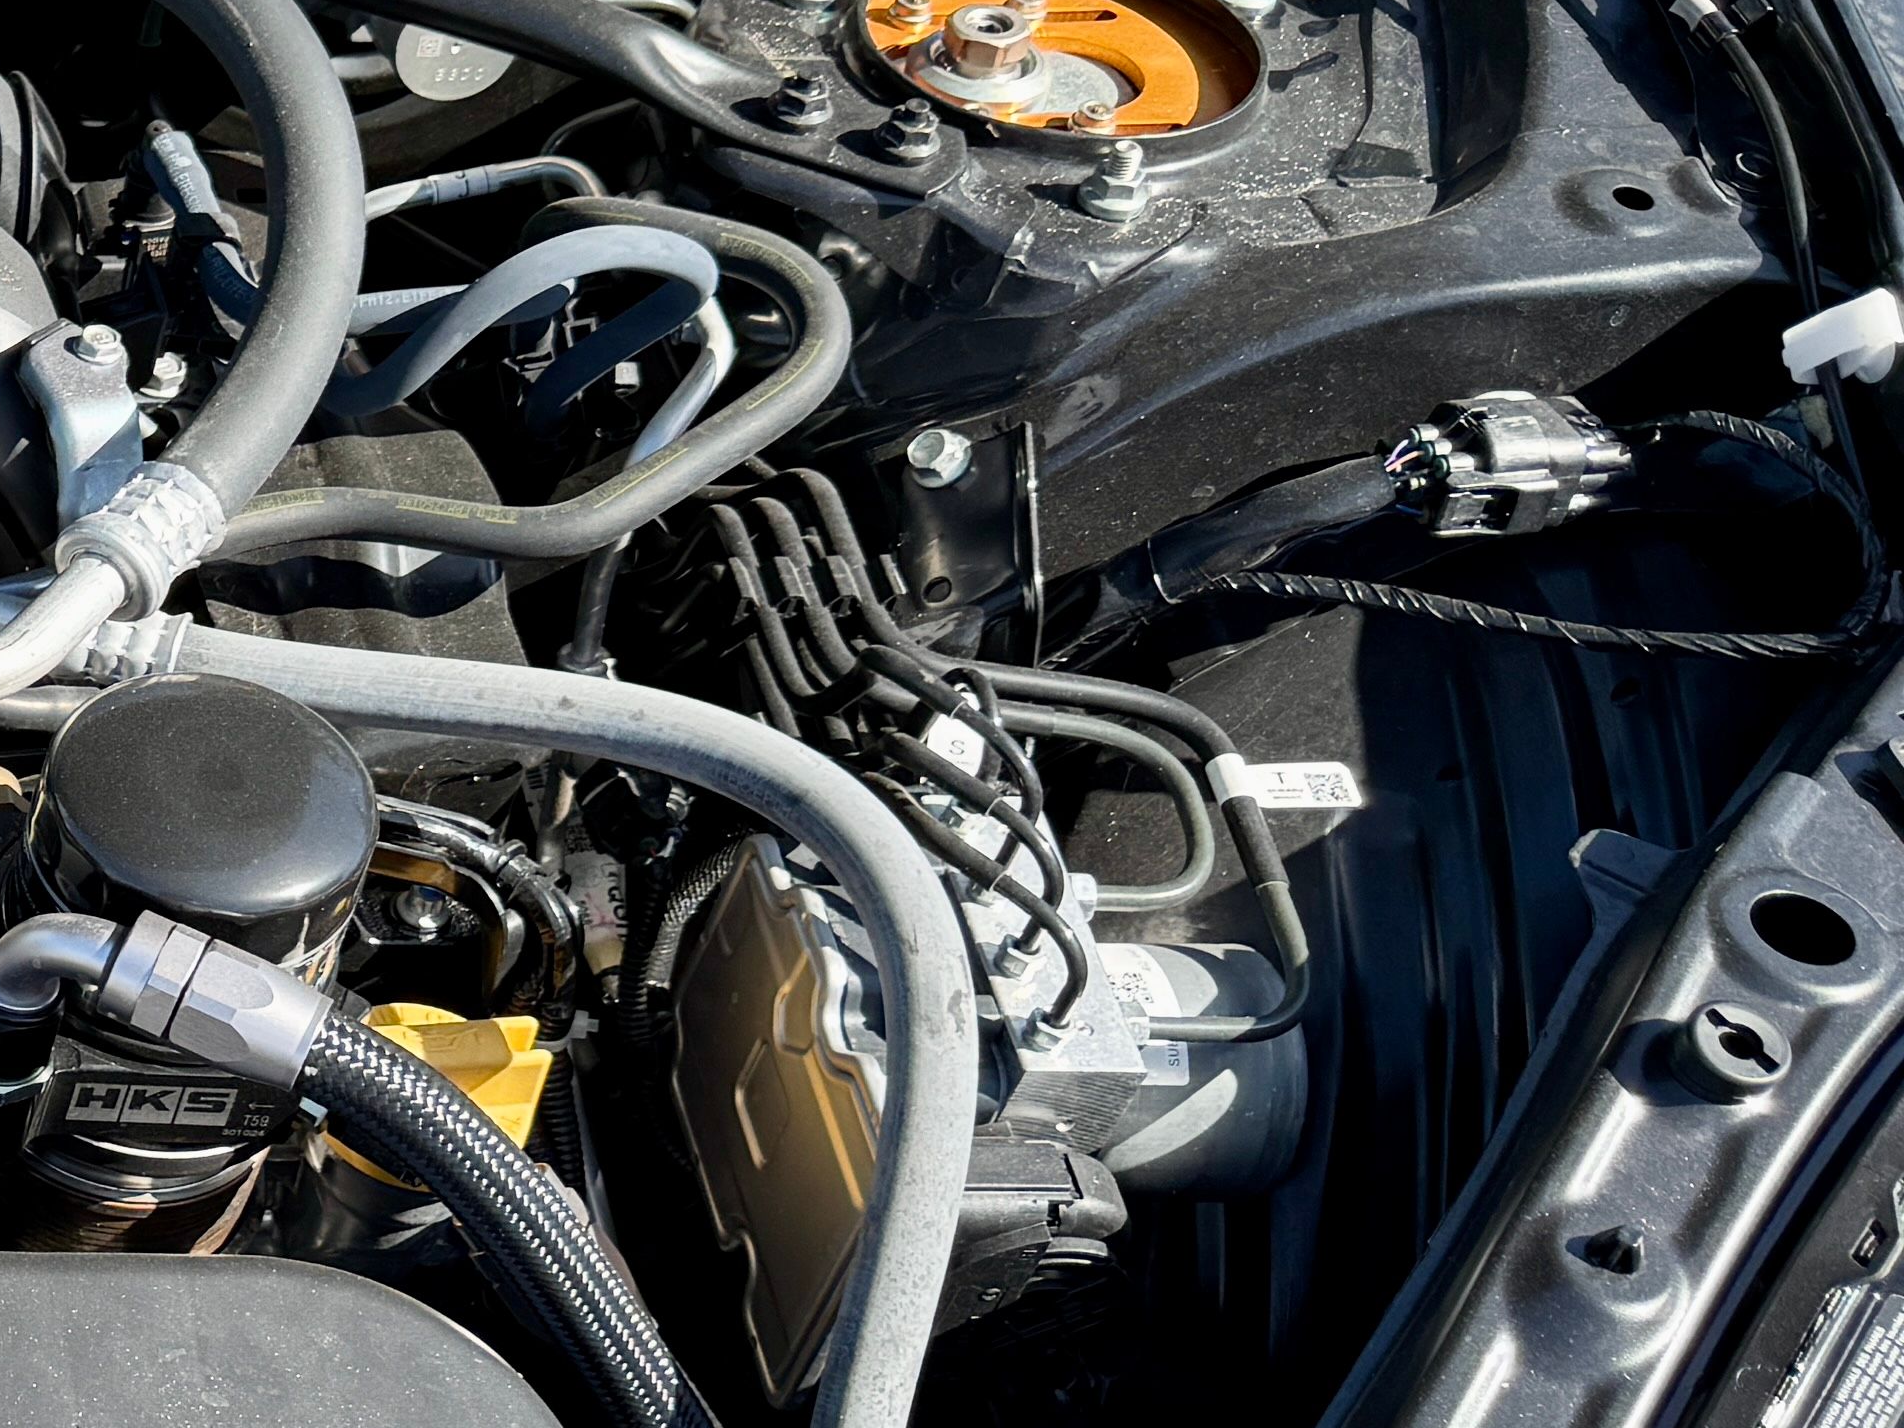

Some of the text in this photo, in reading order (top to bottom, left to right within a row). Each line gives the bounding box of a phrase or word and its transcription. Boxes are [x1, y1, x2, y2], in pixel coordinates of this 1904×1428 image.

[948, 739, 965, 755] S
[1271, 770, 1286, 784] T
[74, 1082, 230, 1118] HKS
